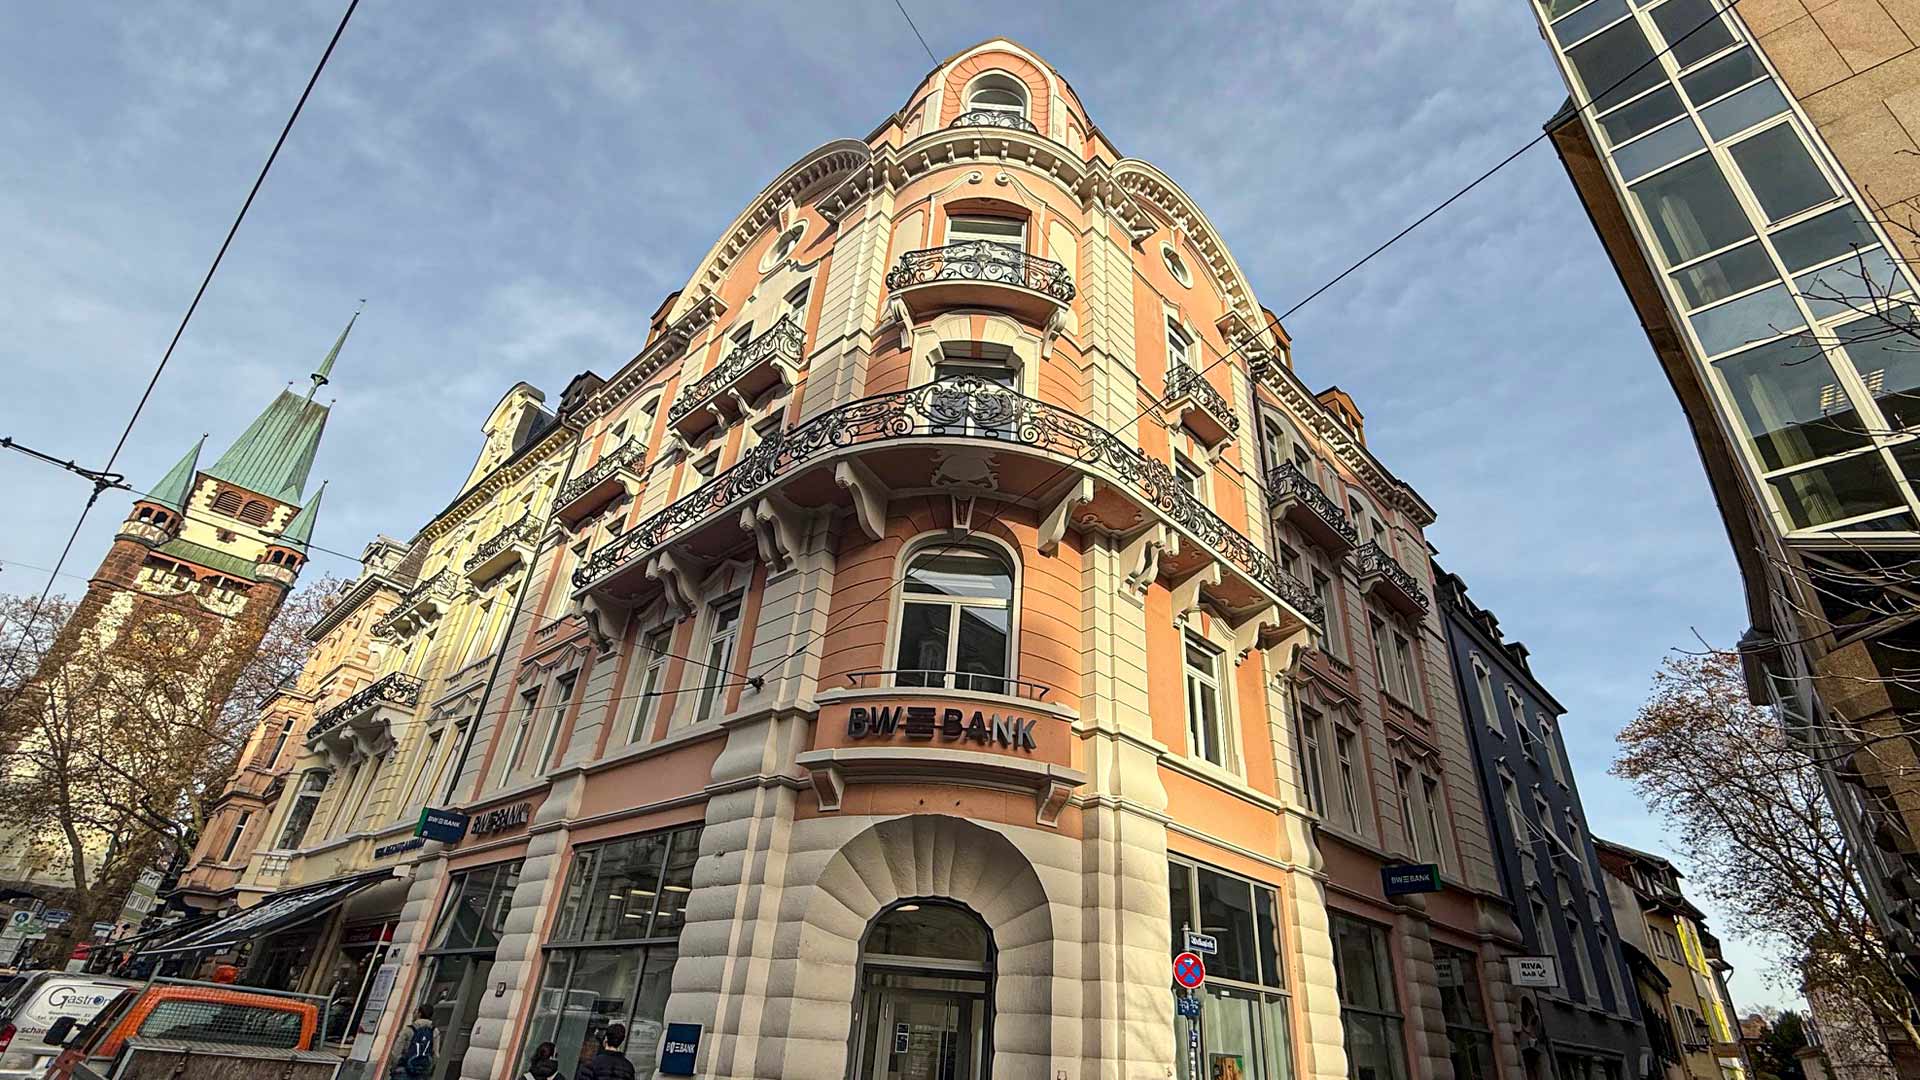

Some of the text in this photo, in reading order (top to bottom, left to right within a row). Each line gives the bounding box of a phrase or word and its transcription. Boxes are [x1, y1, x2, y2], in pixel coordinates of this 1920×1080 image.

[847, 706, 1037, 751] BW BANK
[443, 819, 461, 828] BANK
[1409, 874, 1431, 882] BANK
[1520, 962, 1543, 970] RIVA
[680, 1043, 696, 1053] BANK
